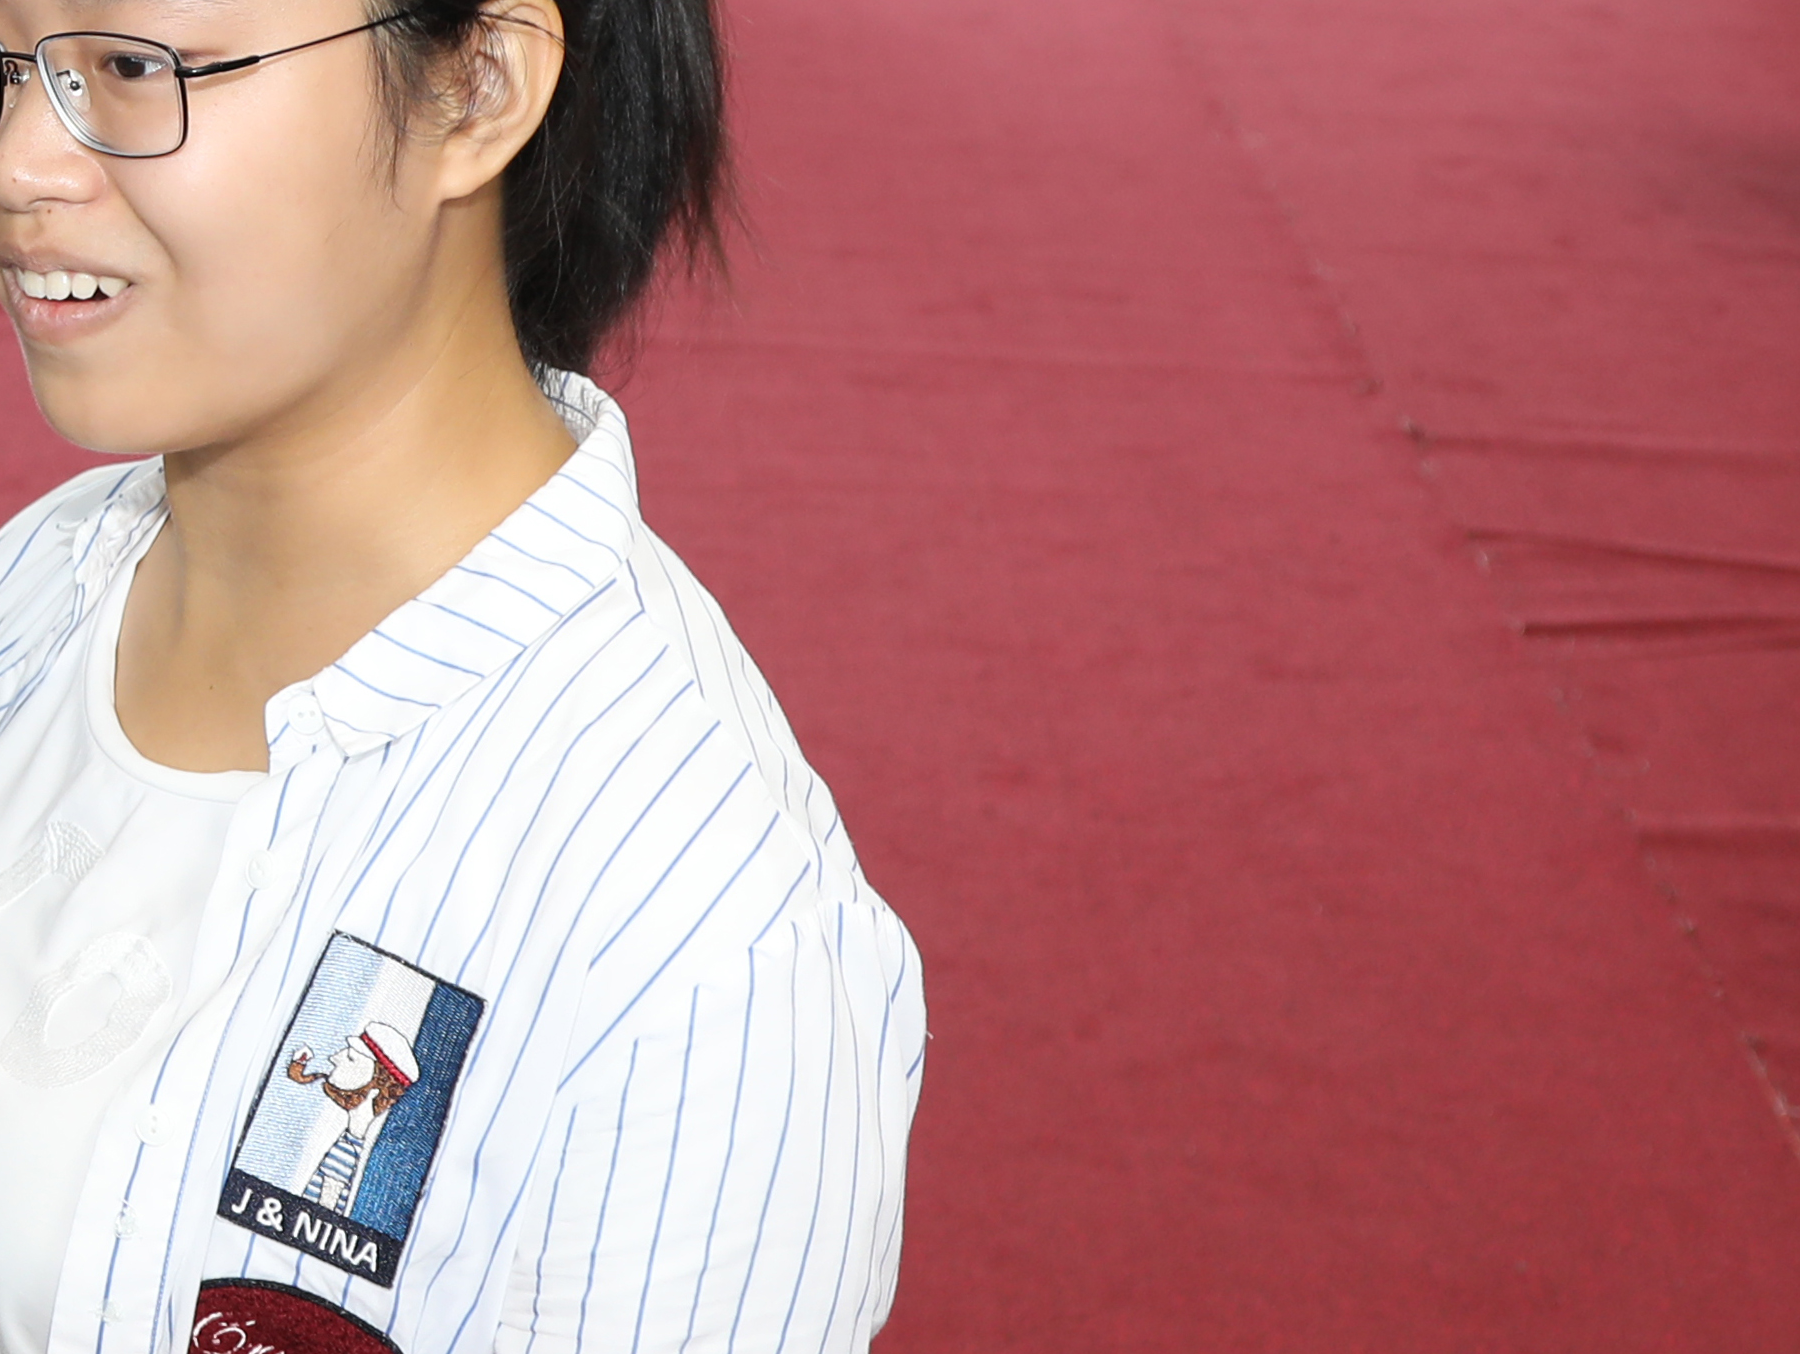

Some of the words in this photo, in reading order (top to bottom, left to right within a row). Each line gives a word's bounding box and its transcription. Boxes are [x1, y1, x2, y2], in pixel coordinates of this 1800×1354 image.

[231, 1188, 252, 1214] J
[256, 1197, 284, 1231] &
[293, 1211, 379, 1273] NINA
